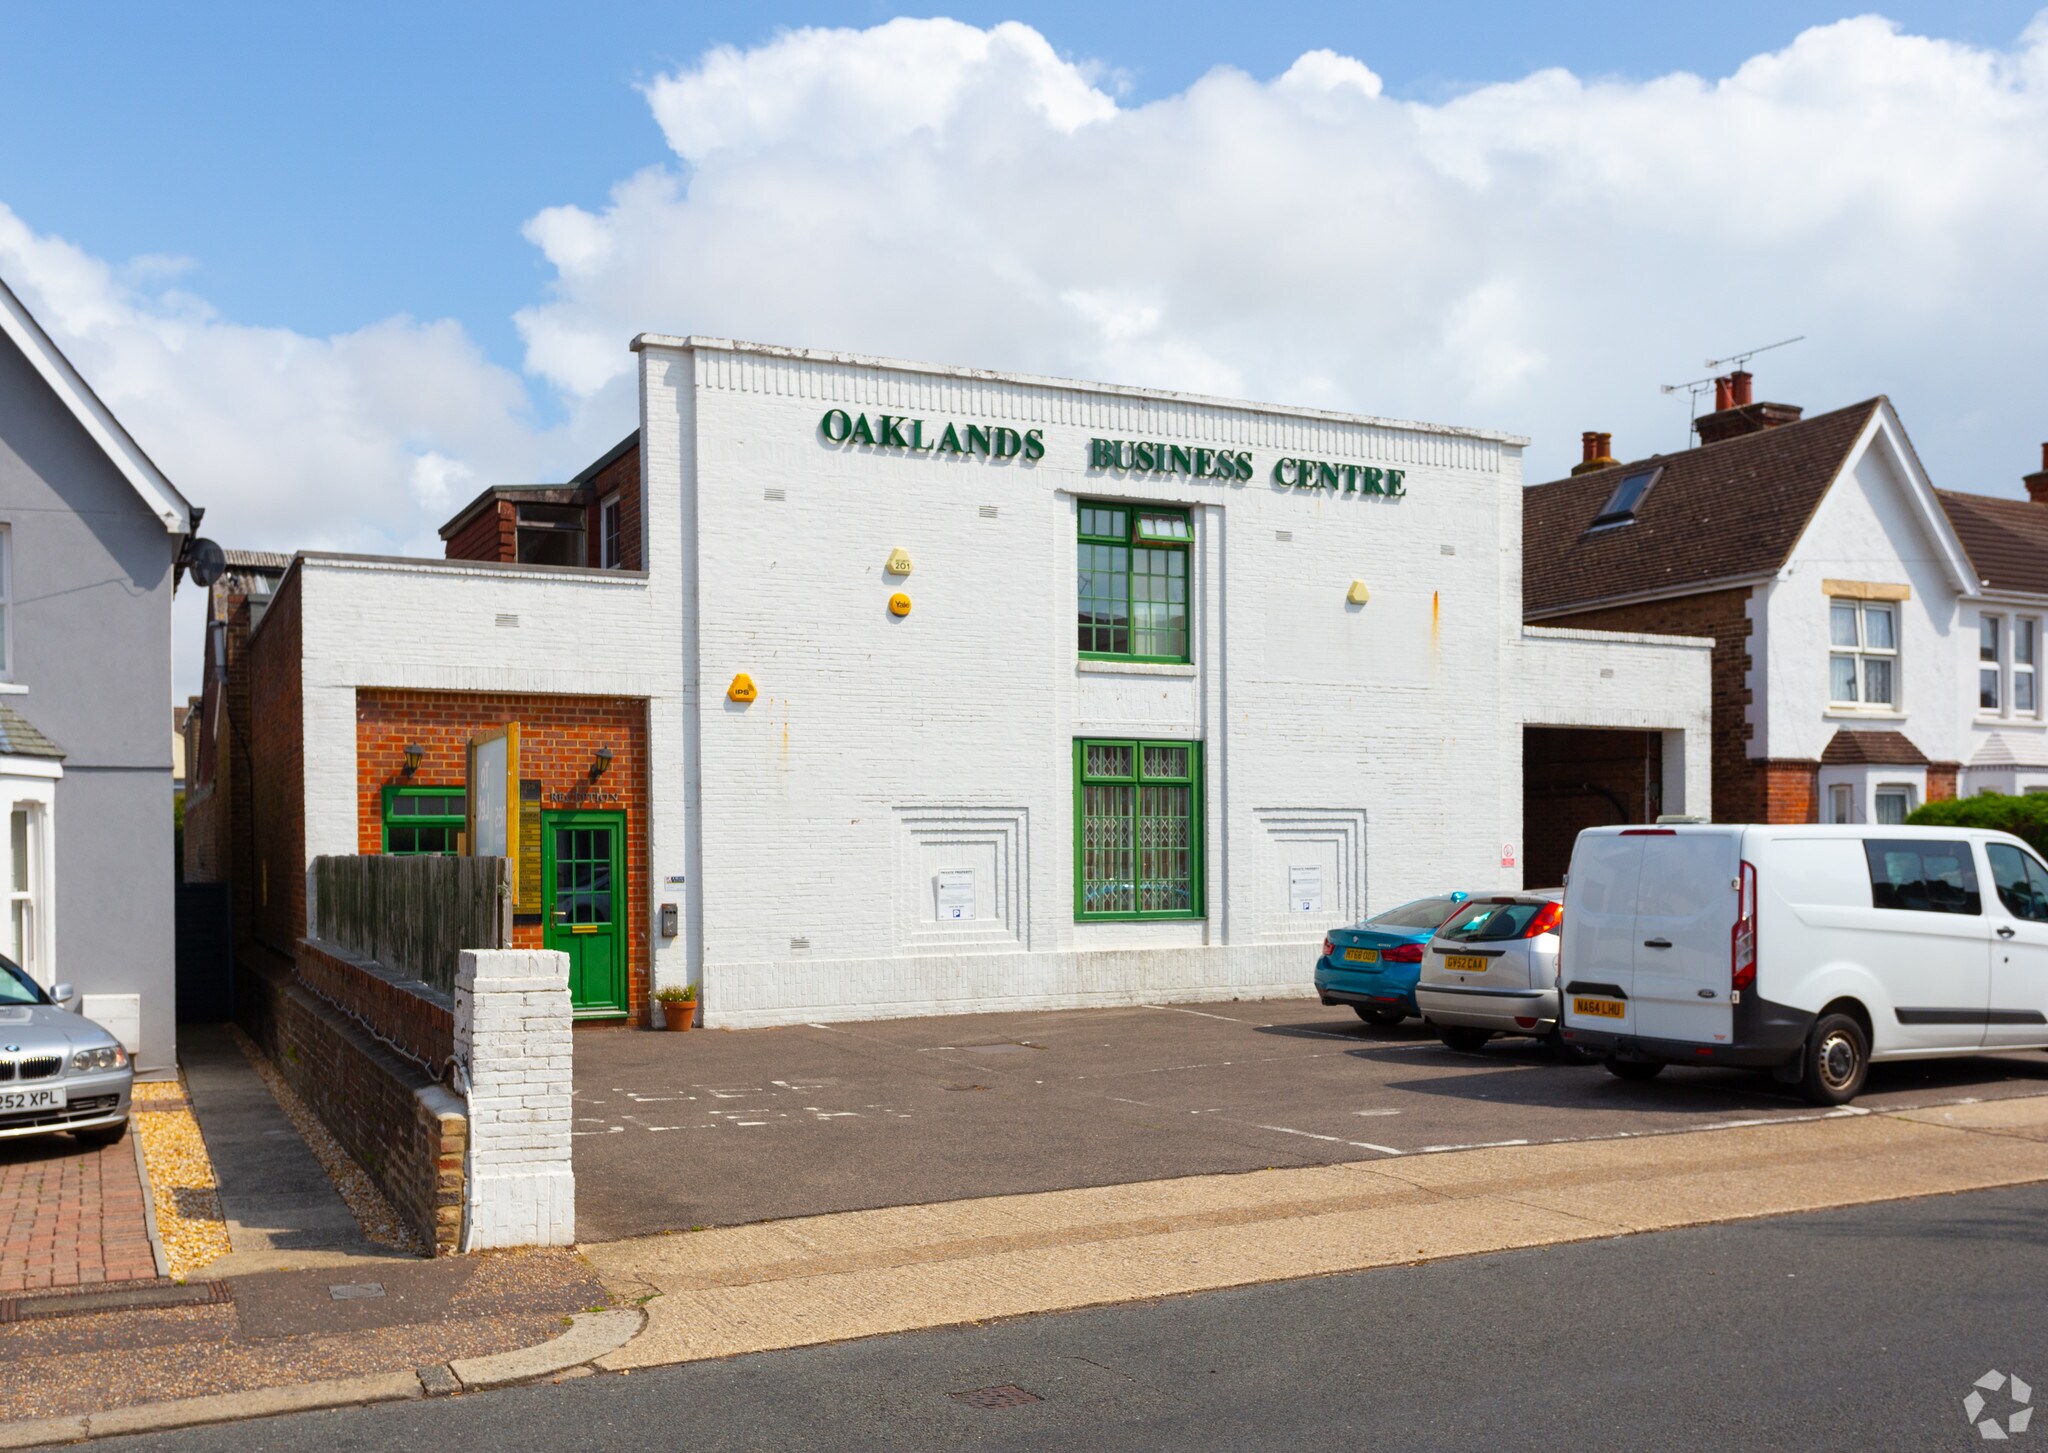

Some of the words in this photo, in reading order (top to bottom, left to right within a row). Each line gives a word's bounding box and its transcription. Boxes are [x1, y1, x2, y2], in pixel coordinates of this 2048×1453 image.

[821, 409, 1045, 460] OAKLANDS
[1091, 438, 1254, 481] BUSINESS
[1274, 457, 1407, 498] CENTRE
[895, 562, 910, 570] 201
[895, 601, 910, 609] Yale
[551, 792, 619, 803] RECEPTION
[1447, 957, 1466, 968] GV52
[1467, 958, 1482, 968] CAA
[1577, 999, 1600, 1014] NA64
[1602, 1002, 1620, 1016] LHU
[30, 1091, 59, 1107] XPL
